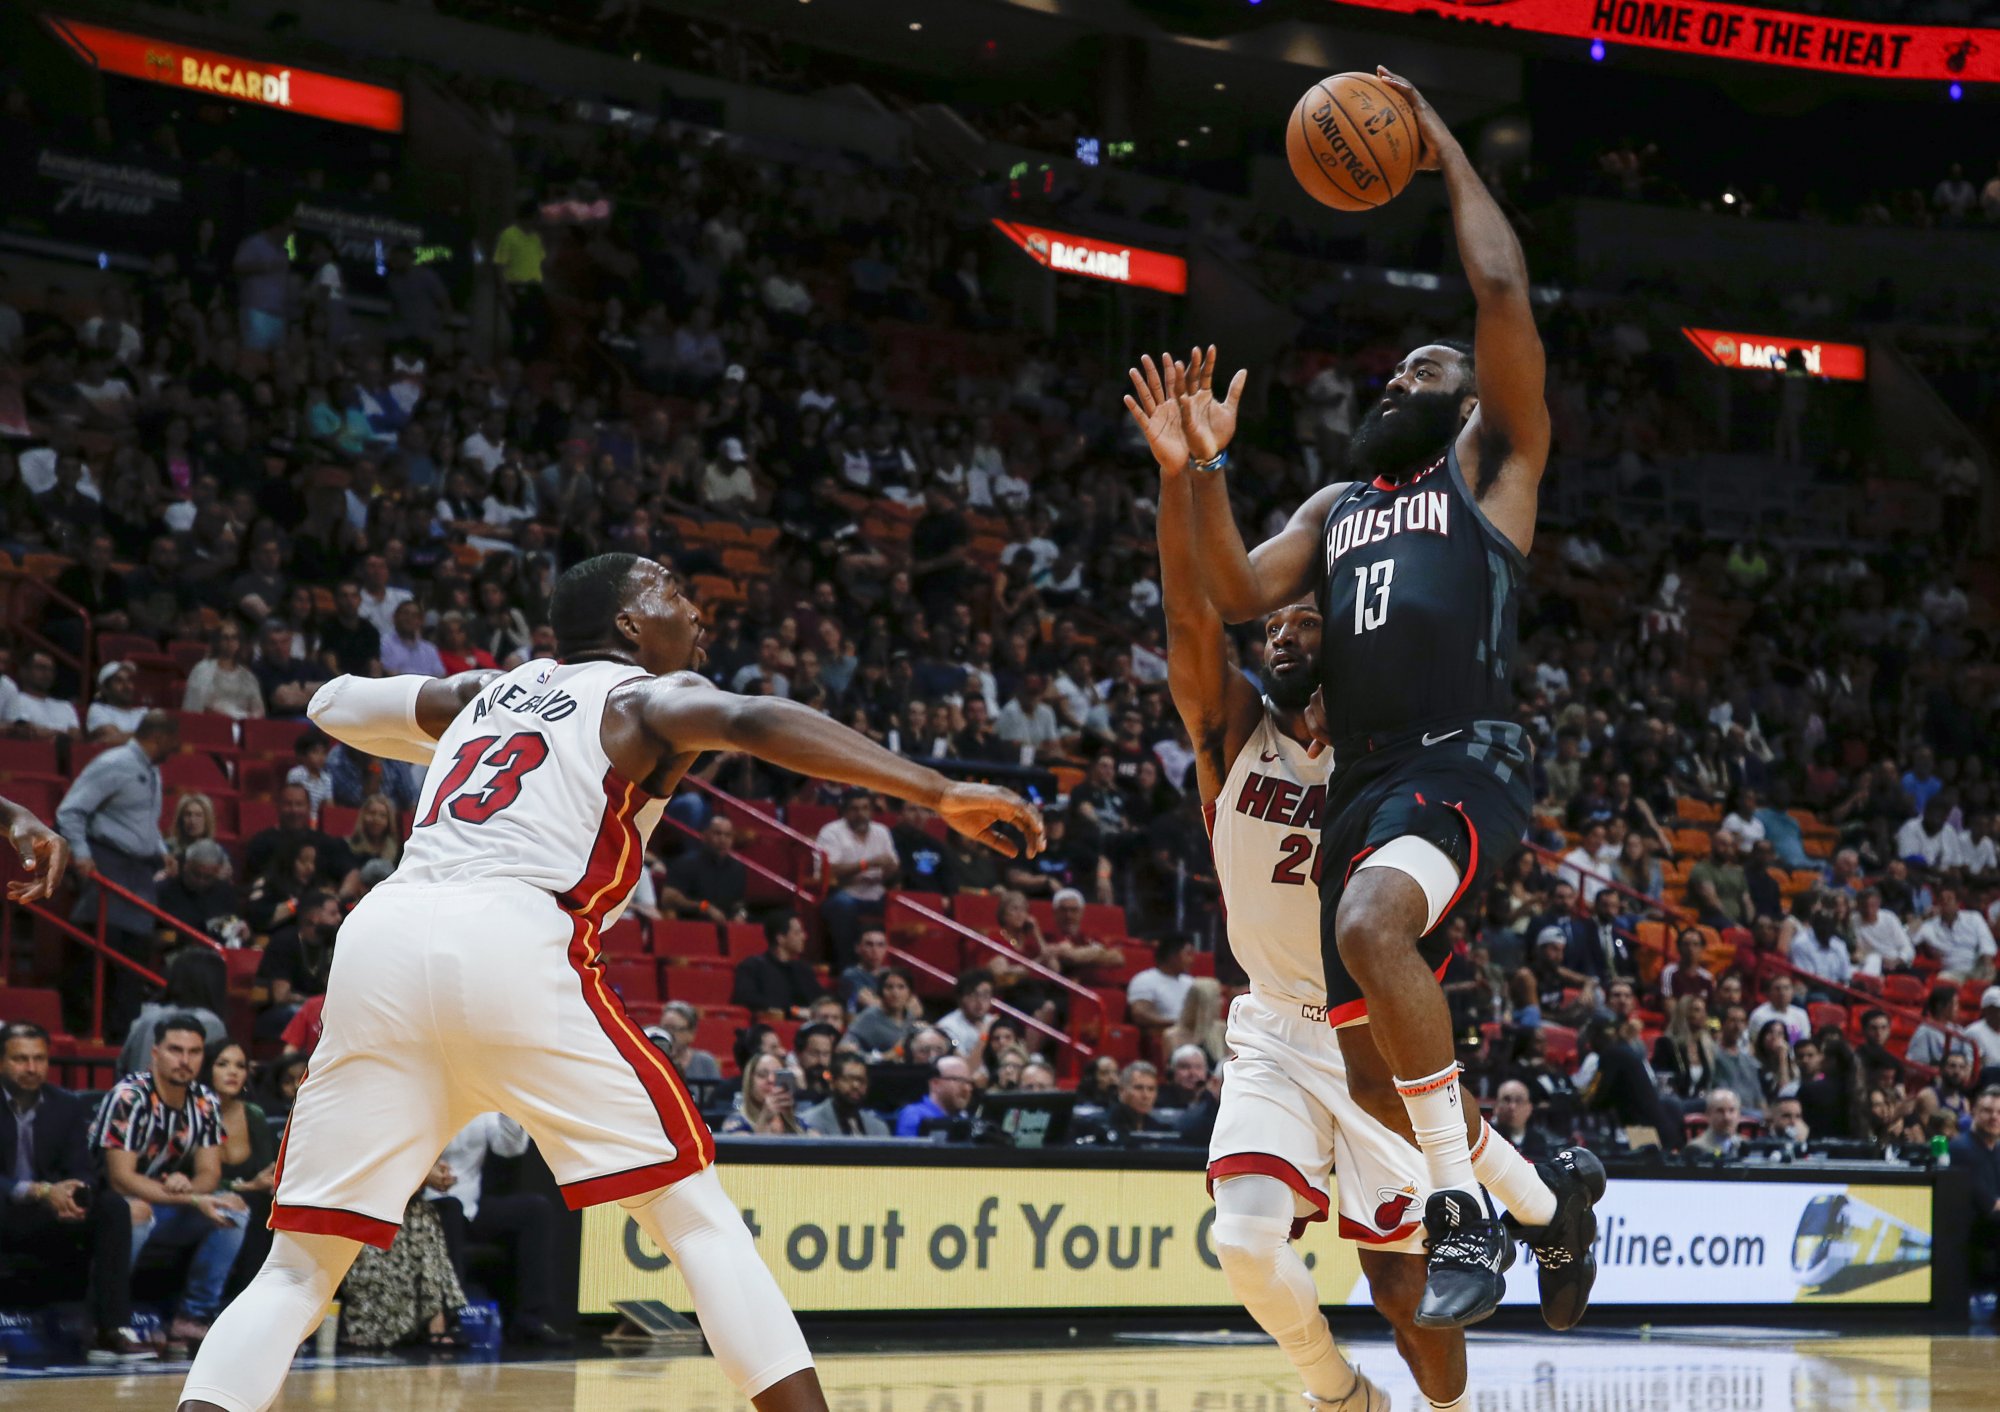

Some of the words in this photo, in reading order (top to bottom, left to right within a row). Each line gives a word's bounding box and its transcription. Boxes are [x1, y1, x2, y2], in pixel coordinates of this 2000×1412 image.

[1592, 0, 1693, 43] HOME
[1701, 11, 1744, 48] OF
[1754, 17, 1814, 59] THE
[1821, 28, 1912, 69] HEAT
[181, 56, 292, 106] BACARDÍ
[1312, 102, 1379, 190] SPALDING
[1050, 241, 1131, 281] BACARDÍ
[1326, 491, 1448, 577] HOUSTON
[1354, 558, 1395, 636] 13
[414, 731, 550, 828] 13
[1235, 771, 1327, 830] HEA
[786, 1209, 905, 1272] out
[928, 1196, 1000, 1271] of
[1019, 1203, 1174, 1270] Your
